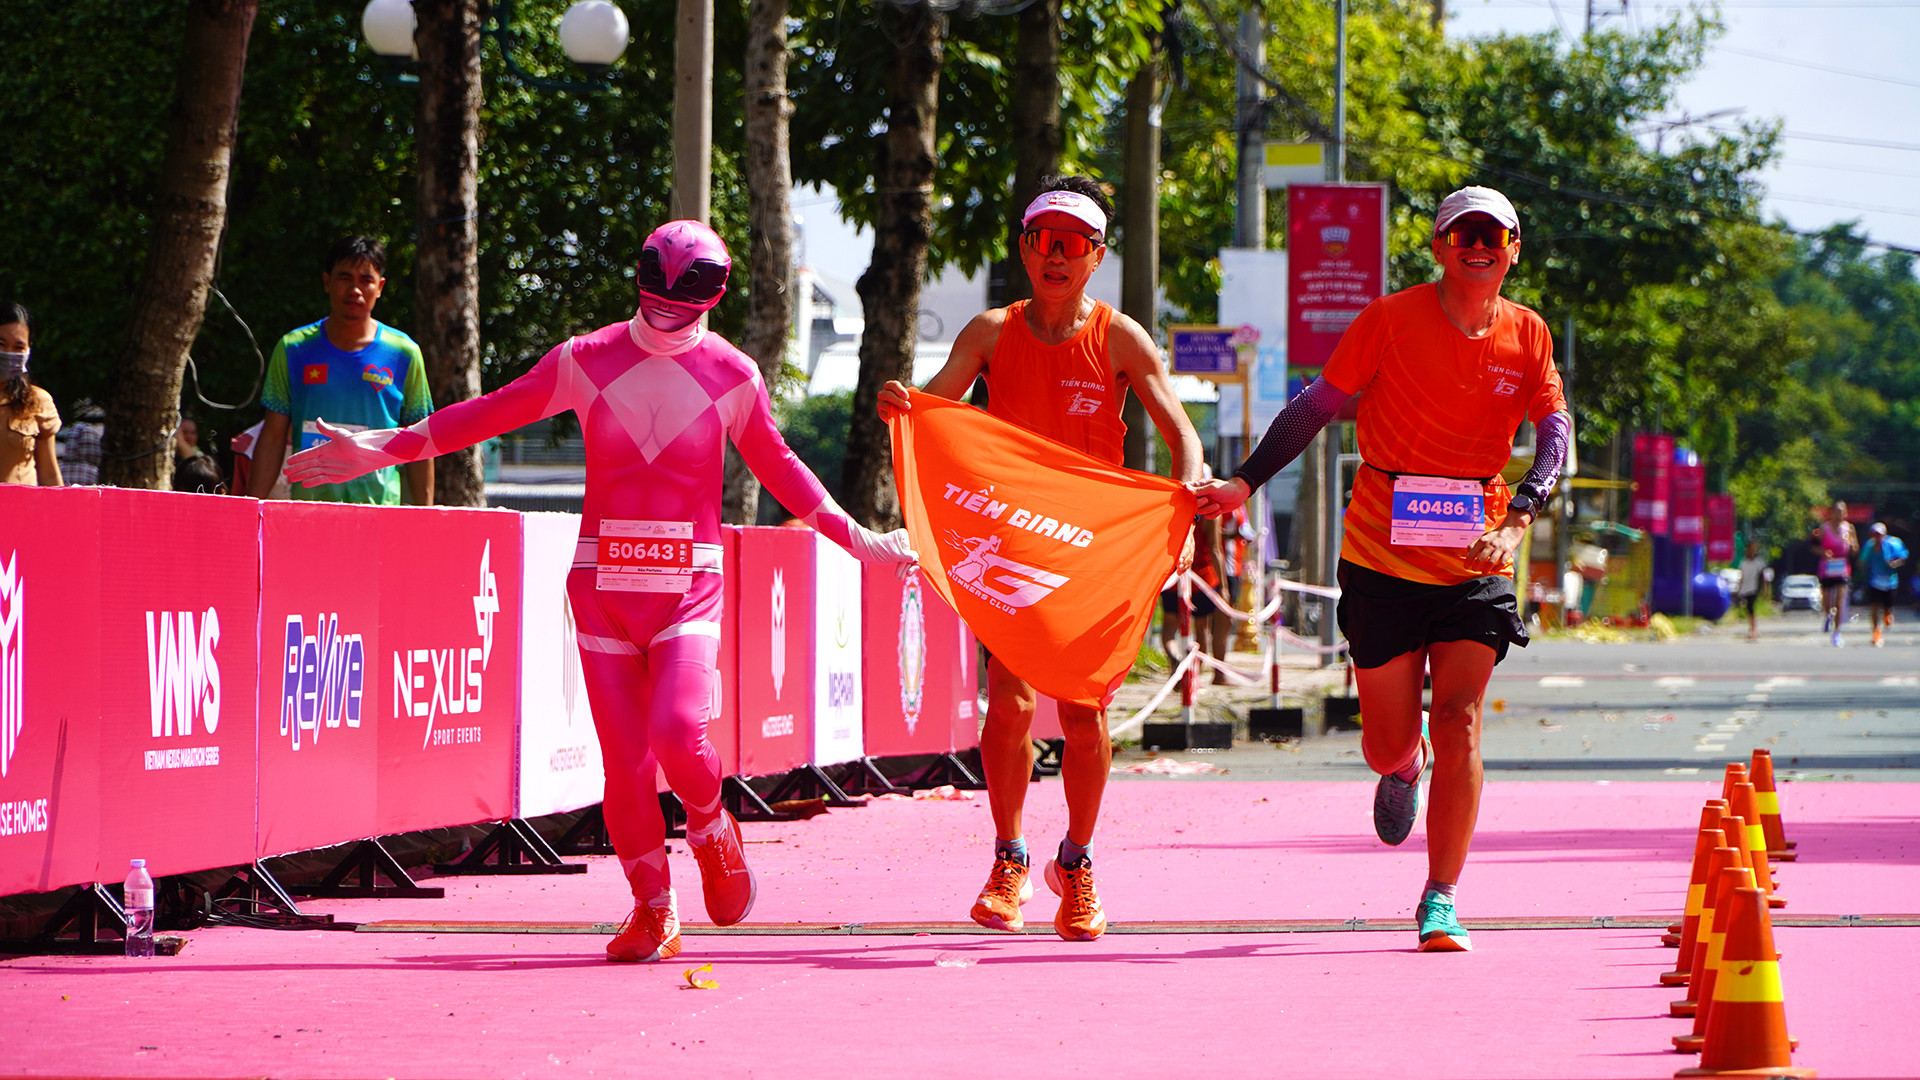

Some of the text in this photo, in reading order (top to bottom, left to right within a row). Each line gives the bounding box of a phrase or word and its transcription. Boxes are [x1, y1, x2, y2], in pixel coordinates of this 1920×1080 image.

[1407, 499, 1465, 516] 40486
[1006, 508, 1094, 548] GIANG
[608, 542, 674, 560] 50643
[947, 570, 1017, 616] RUNNERS CLUB
[145, 606, 221, 738] VNMS
[393, 647, 483, 751] NEXUS
[433, 726, 482, 746] SPORT EVENTS
[14, 798, 48, 834] HOMES
